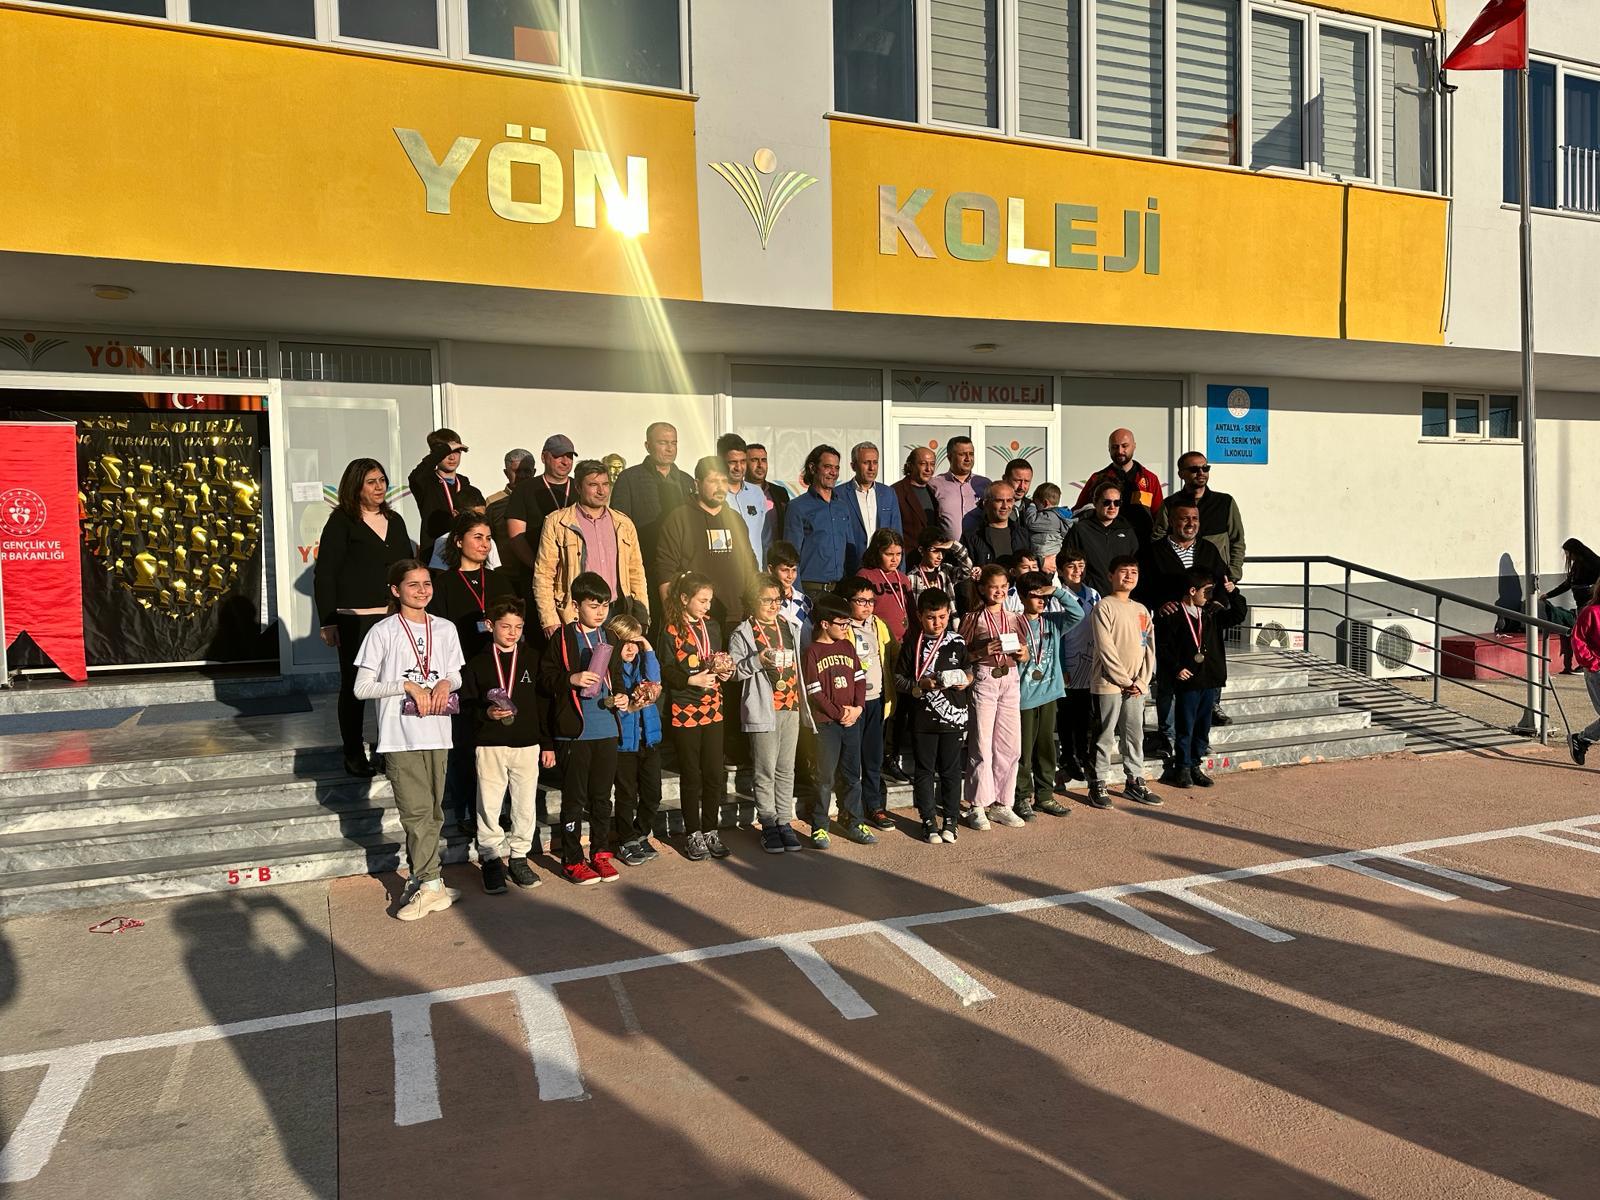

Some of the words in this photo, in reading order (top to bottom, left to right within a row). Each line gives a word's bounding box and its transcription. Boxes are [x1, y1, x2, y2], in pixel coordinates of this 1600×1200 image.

[392, 123, 650, 235] YÖN
[877, 185, 1160, 276] KOLEJİ
[85, 341, 146, 369] YÖN
[949, 381, 982, 402] YÖN
[988, 384, 1045, 404] KOLEJİ
[1215, 424, 1240, 432] ANTALYA
[1244, 424, 1262, 433] SERİK
[1215, 434, 1230, 444] ÖZEL
[1232, 435, 1249, 445] SERİK
[1250, 436, 1262, 445] YÖN
[1225, 447, 1253, 457] İLKOKULU
[2, 540, 46, 551] GENÇLİK
[47, 541, 61, 549] VE
[9, 549, 65, 560] BAKANLIĞI
[816, 654, 855, 674] HOUSTON
[520, 669, 532, 683] A
